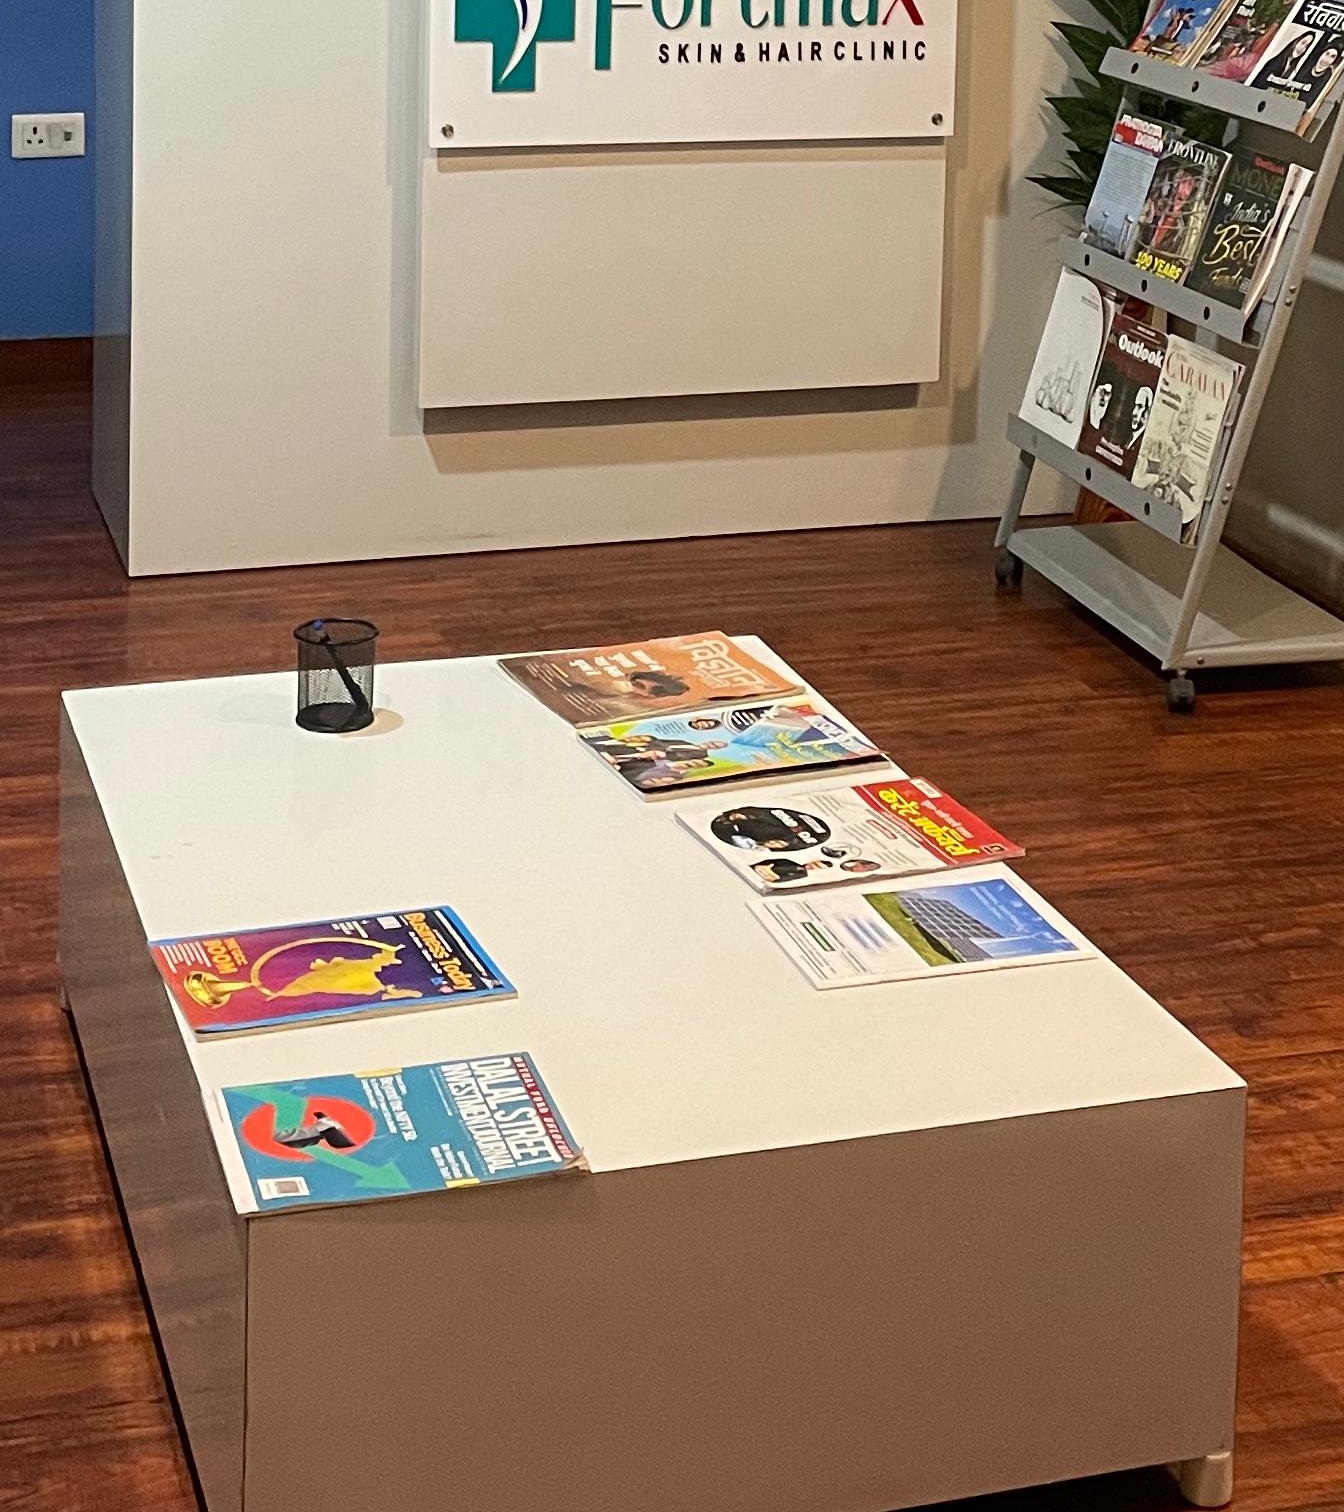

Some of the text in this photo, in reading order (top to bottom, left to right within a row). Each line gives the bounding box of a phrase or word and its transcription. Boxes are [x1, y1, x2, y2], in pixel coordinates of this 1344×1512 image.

[658, 40, 927, 64] SKIN & HAIR CLINIC
[1231, 164, 1286, 196] MONE
[1202, 223, 1273, 265] Best
[1153, 257, 1184, 281] YEARS
[1118, 333, 1164, 369] Outlook
[404, 912, 476, 990] Business Today
[470, 1057, 531, 1110] DALAL
[494, 1106, 562, 1167] STREET
